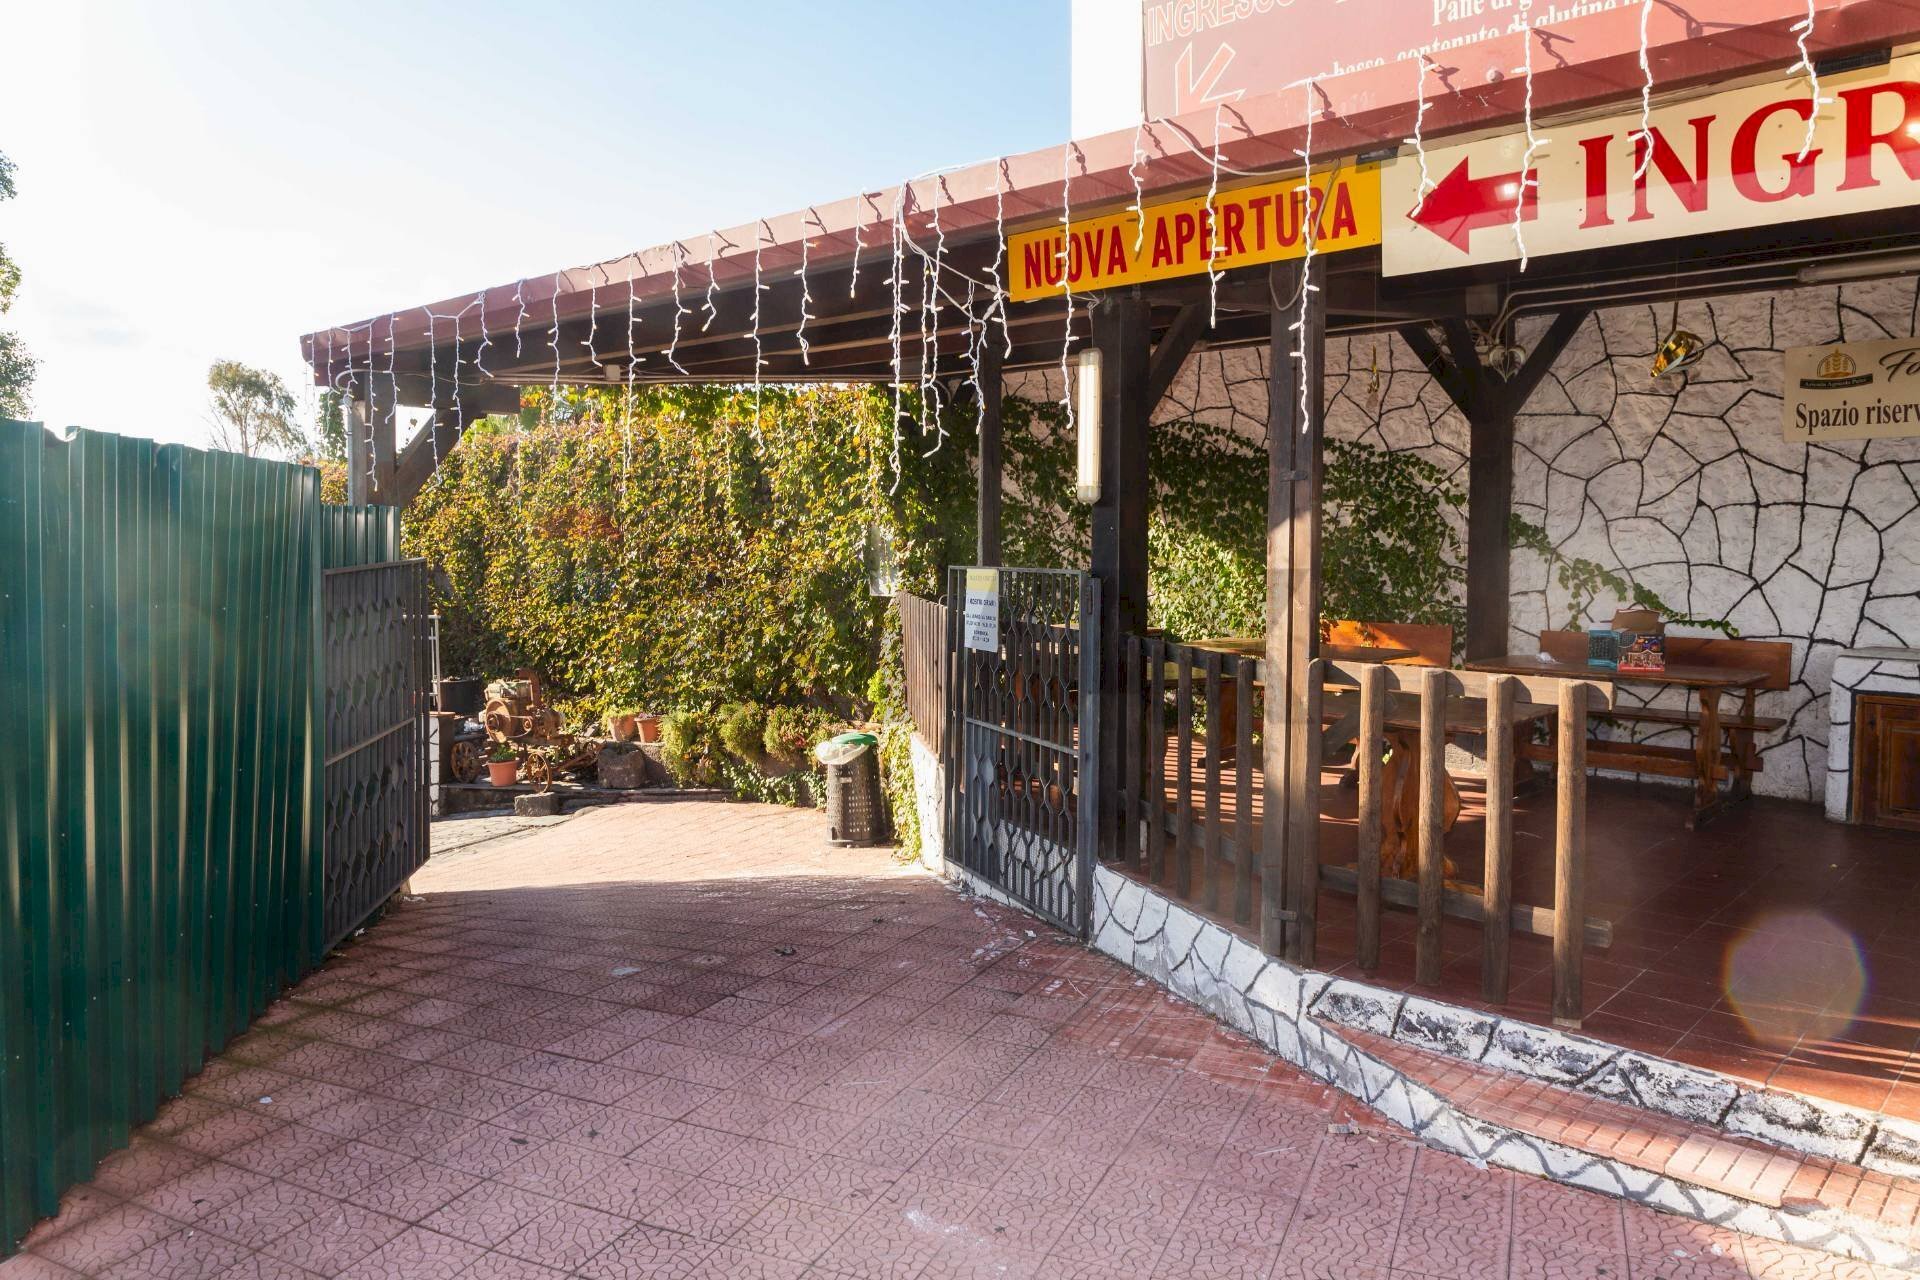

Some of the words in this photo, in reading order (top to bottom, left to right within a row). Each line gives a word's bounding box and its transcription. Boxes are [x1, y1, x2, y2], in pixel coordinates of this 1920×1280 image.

[1023, 225, 1128, 289] NUOVA
[1151, 181, 1358, 269] APERTURA
[1796, 400, 1859, 435] Spazio
